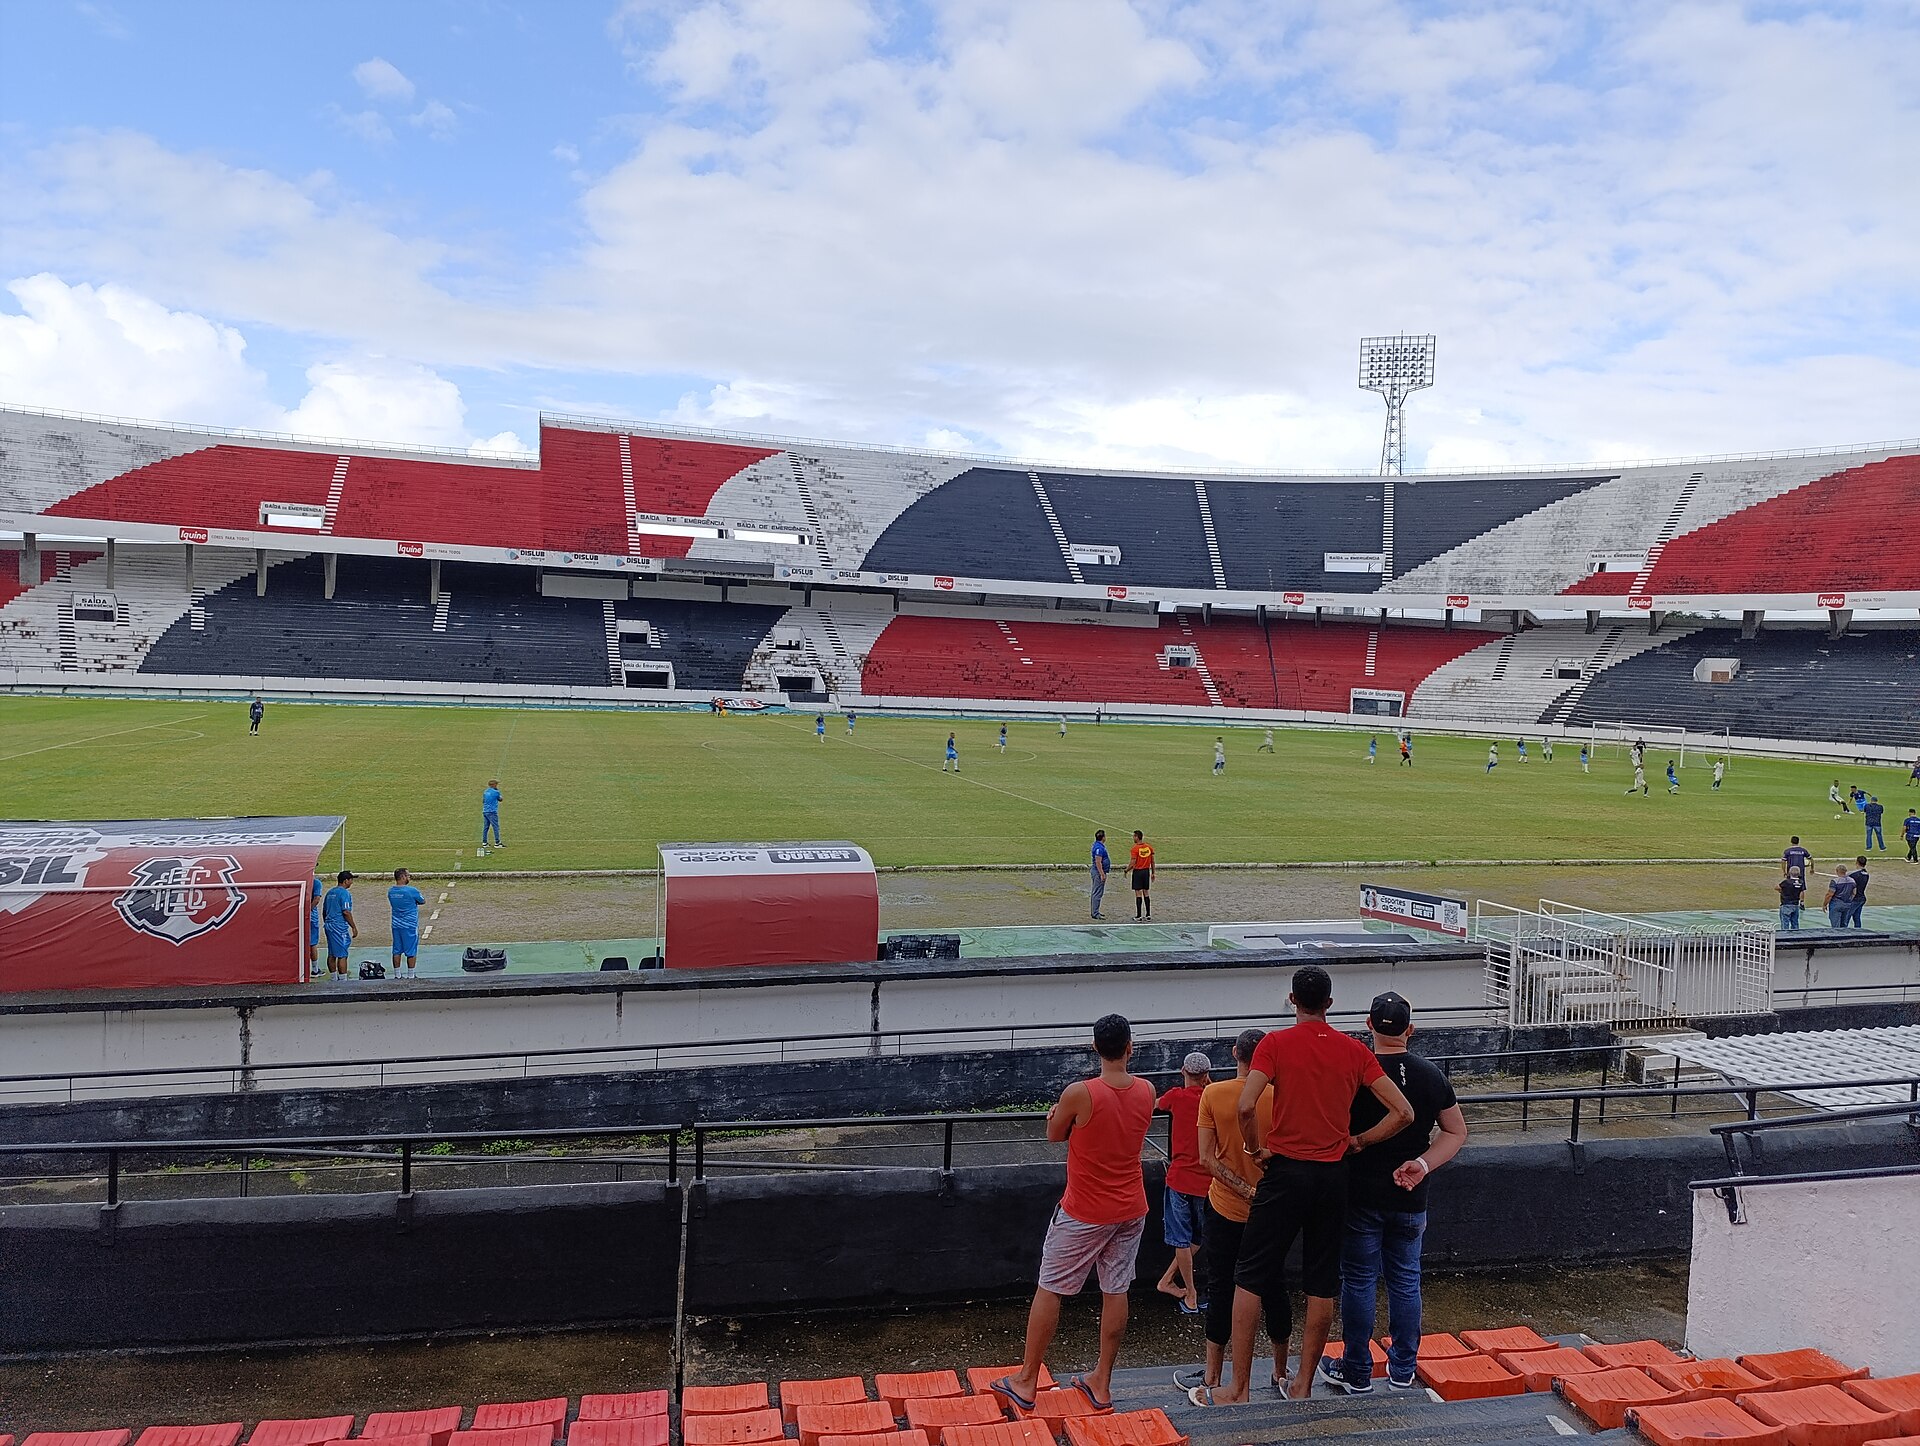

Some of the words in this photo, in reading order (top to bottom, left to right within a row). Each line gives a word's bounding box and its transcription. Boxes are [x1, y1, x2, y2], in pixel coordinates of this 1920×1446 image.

[180, 529, 207, 540] Iquine
[398, 544, 422, 556] Iquine
[574, 553, 599, 561] DISLUB
[626, 557, 650, 565] DISLUB
[1629, 597, 1651, 608] Iquine
[1818, 596, 1844, 606] Iquine
[1329, 1370, 1344, 1379] FILA
